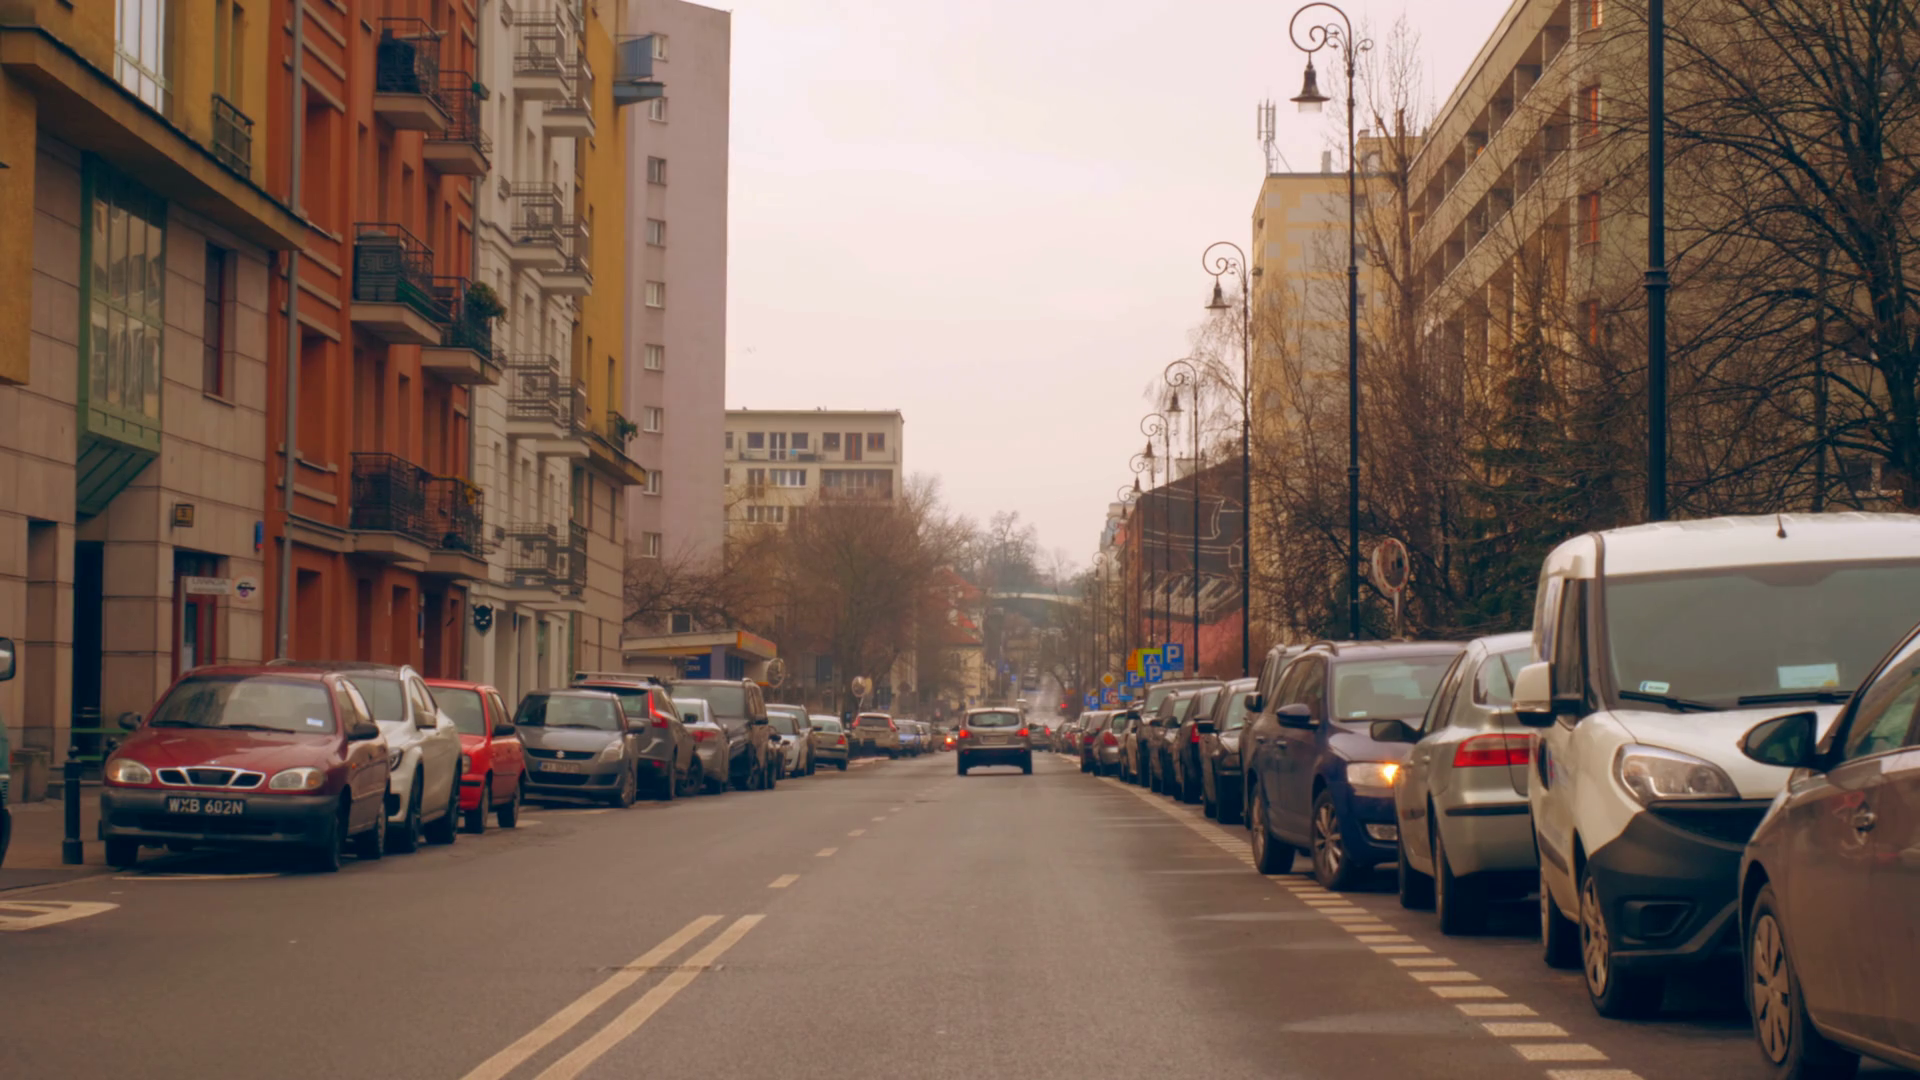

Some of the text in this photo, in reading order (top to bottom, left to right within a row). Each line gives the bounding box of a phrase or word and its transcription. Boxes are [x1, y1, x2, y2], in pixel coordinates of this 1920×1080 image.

[1167, 645, 1180, 664] P
[1149, 666, 1160, 680] P
[169, 798, 243, 814] WXB 602N
